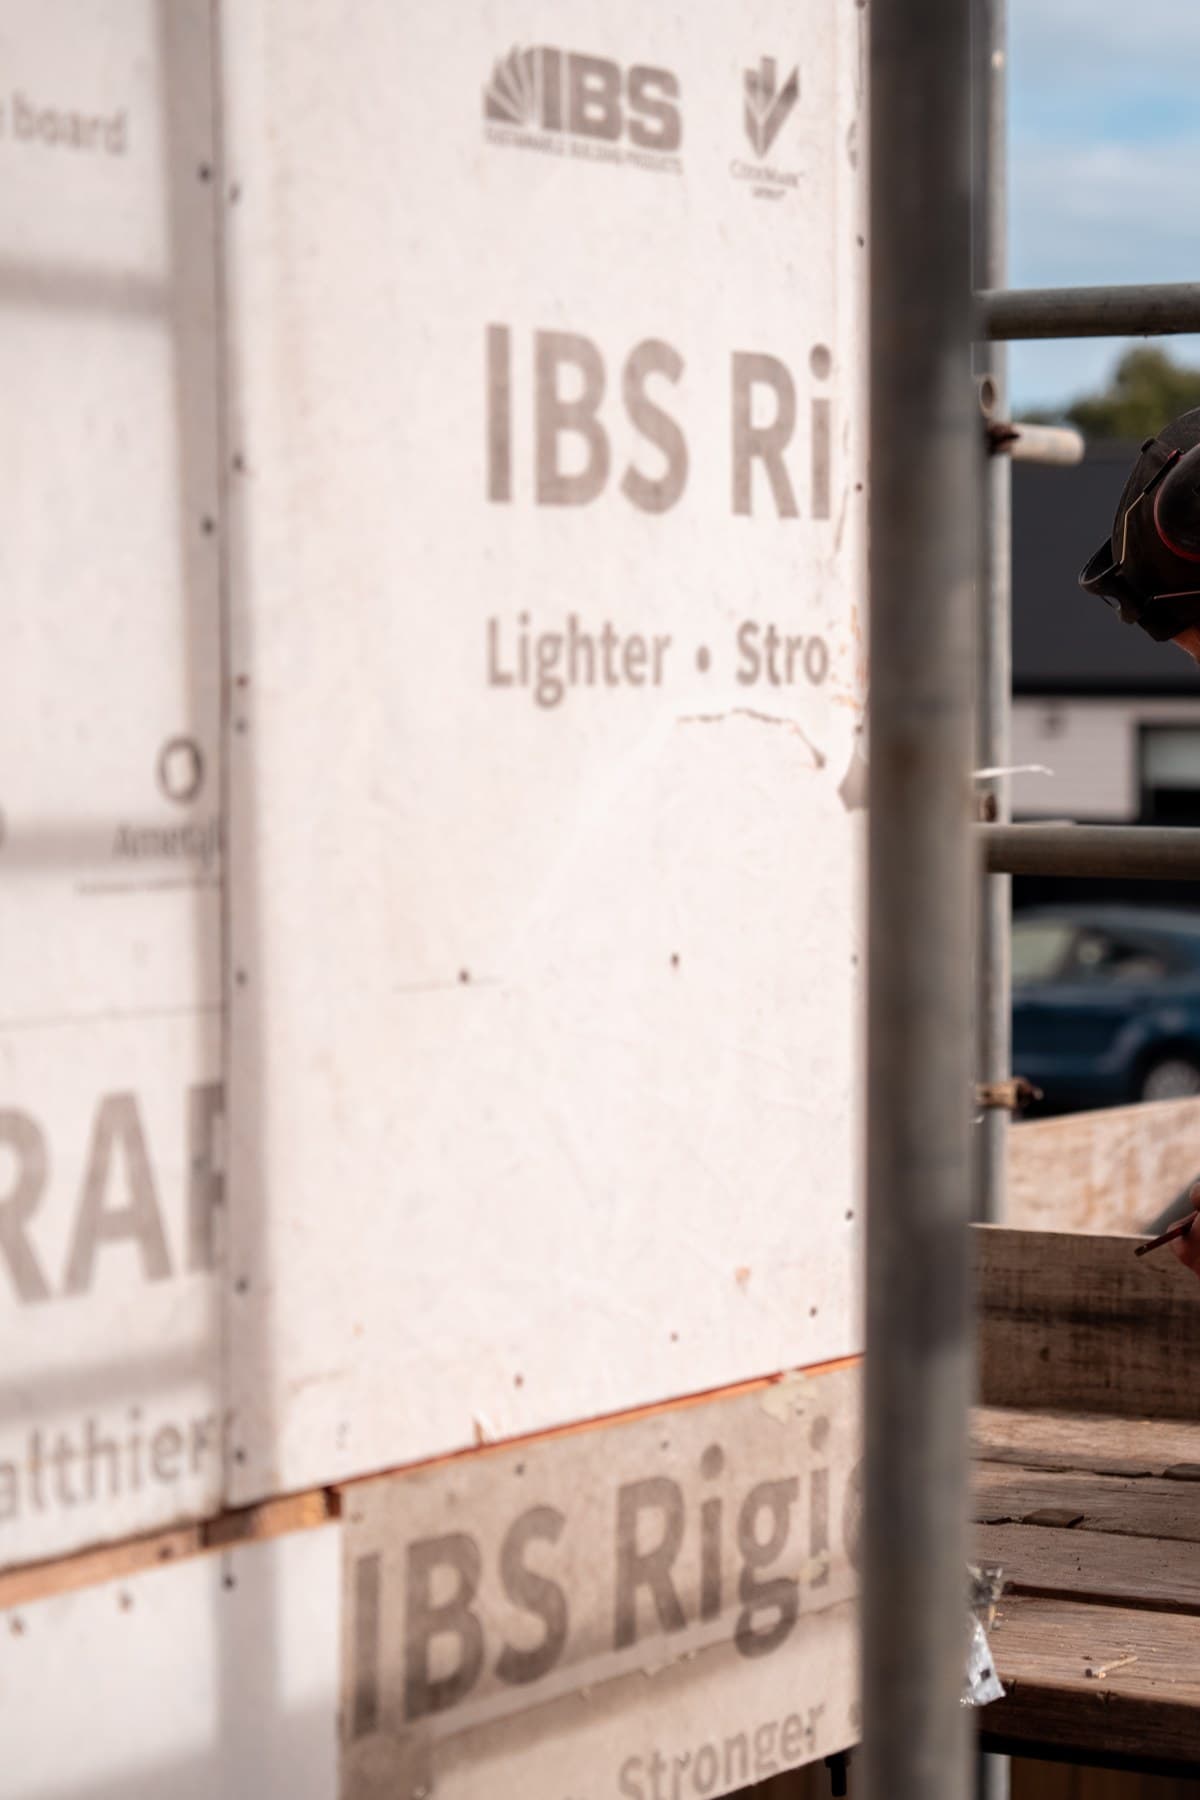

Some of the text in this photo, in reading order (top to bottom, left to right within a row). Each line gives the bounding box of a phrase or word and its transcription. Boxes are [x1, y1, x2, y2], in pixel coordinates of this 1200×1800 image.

[12, 90, 128, 155] board
[541, 46, 683, 152] IBS
[486, 325, 829, 519] IBS Ri
[486, 612, 828, 708] Lighter Stro
[353, 1505, 569, 1738] IBS
[617, 1703, 826, 1800] Stronger
